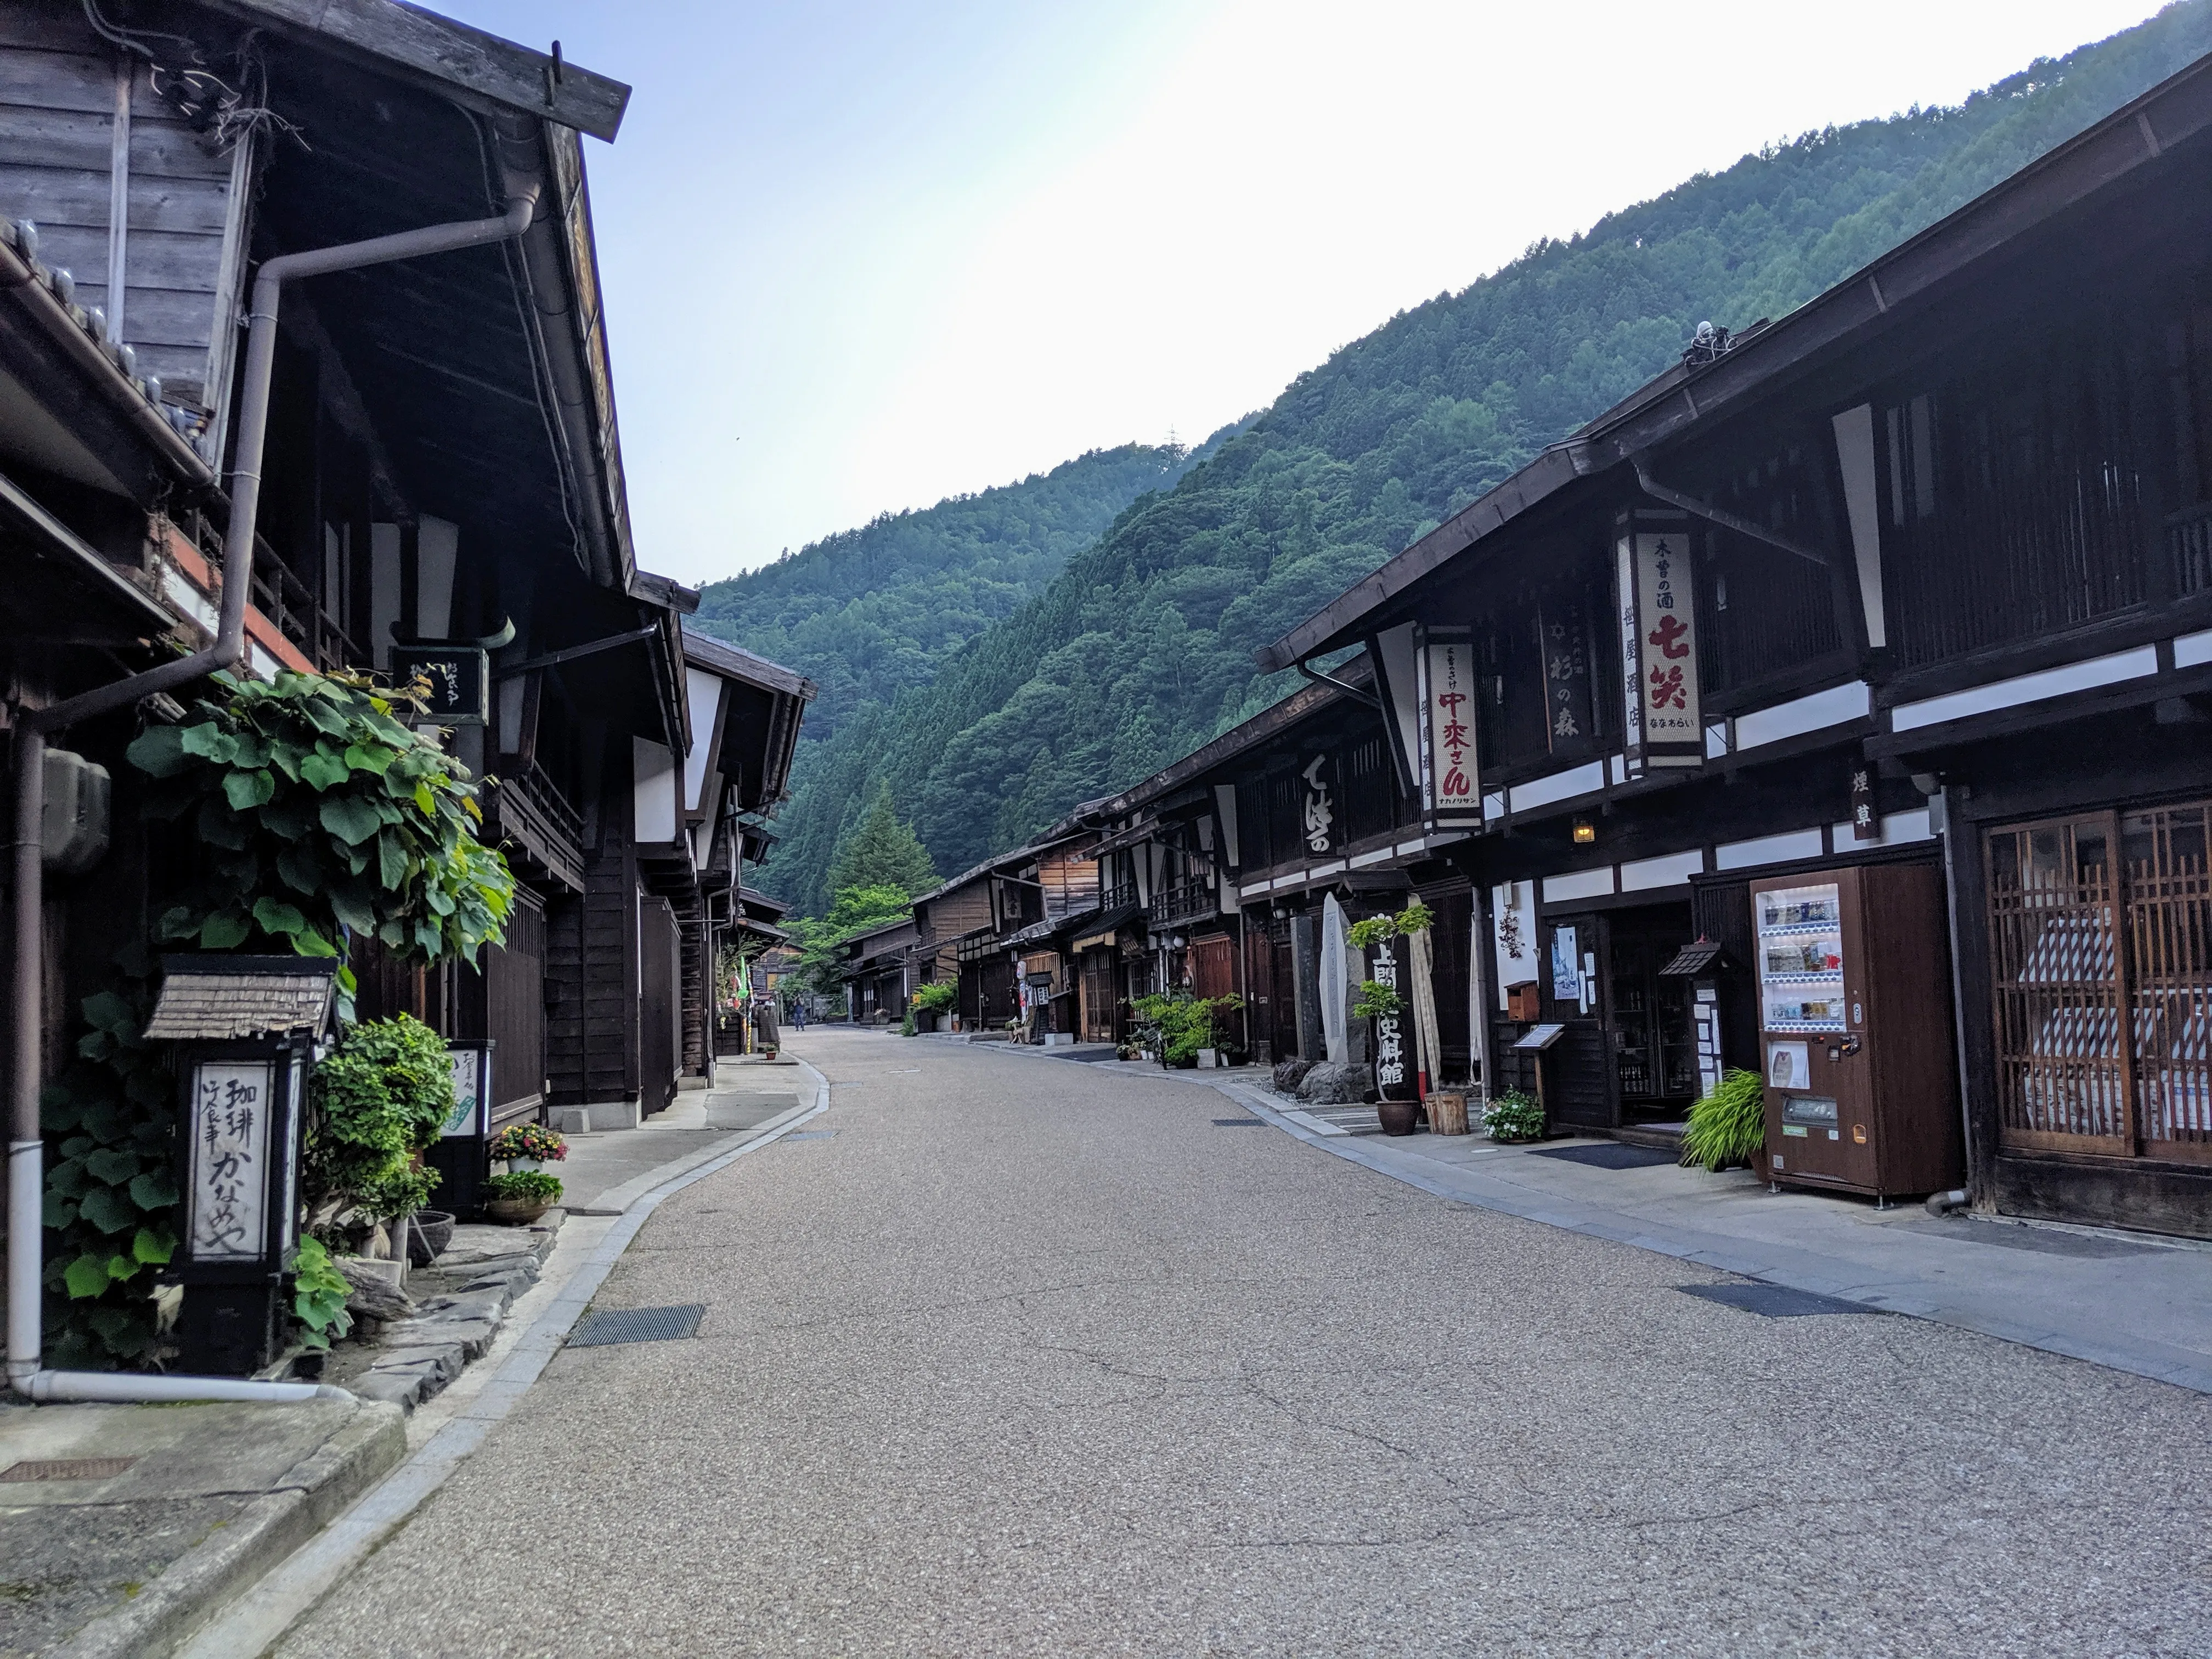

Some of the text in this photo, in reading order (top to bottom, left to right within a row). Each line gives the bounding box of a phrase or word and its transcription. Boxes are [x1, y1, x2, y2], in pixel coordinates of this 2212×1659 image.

[1649, 614, 1689, 709] 七笑
[1650, 718, 1694, 729] ななわらい
[1854, 771, 1871, 827] 煙草
[1373, 943, 1404, 1086] 上問史料館
